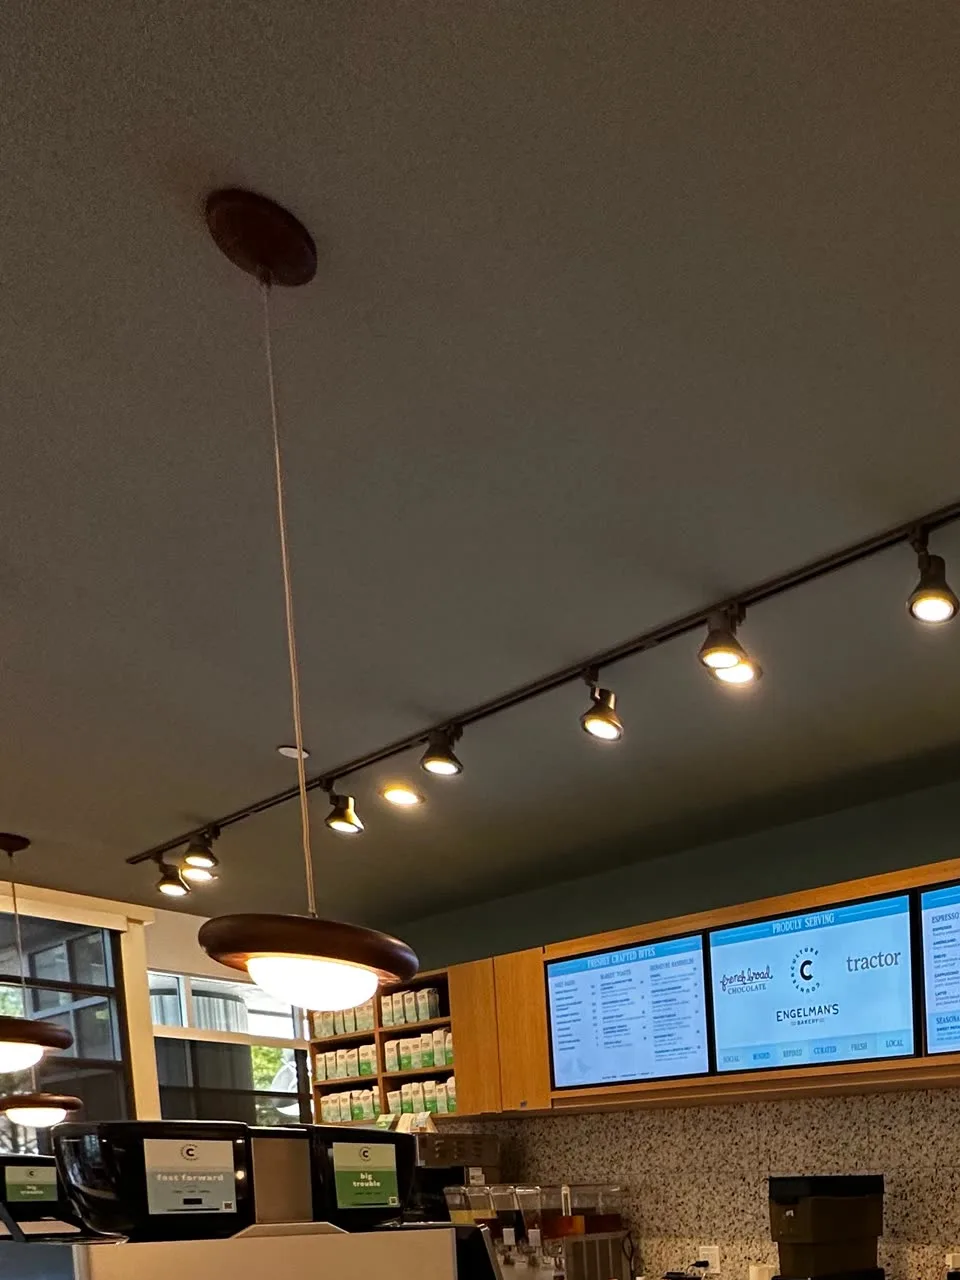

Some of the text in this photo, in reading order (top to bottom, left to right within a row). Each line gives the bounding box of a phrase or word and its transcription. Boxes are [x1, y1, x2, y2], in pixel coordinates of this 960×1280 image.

[805, 913, 834, 928] SERVING
[932, 912, 959, 923] ESPRESSO
[847, 952, 901, 972] tractor
[746, 965, 773, 981] broad
[800, 960, 813, 980] C
[728, 984, 766, 995] CHOCOLATE
[776, 1004, 839, 1022] ENGELMAN'S
[886, 1040, 904, 1048] LOCAL
